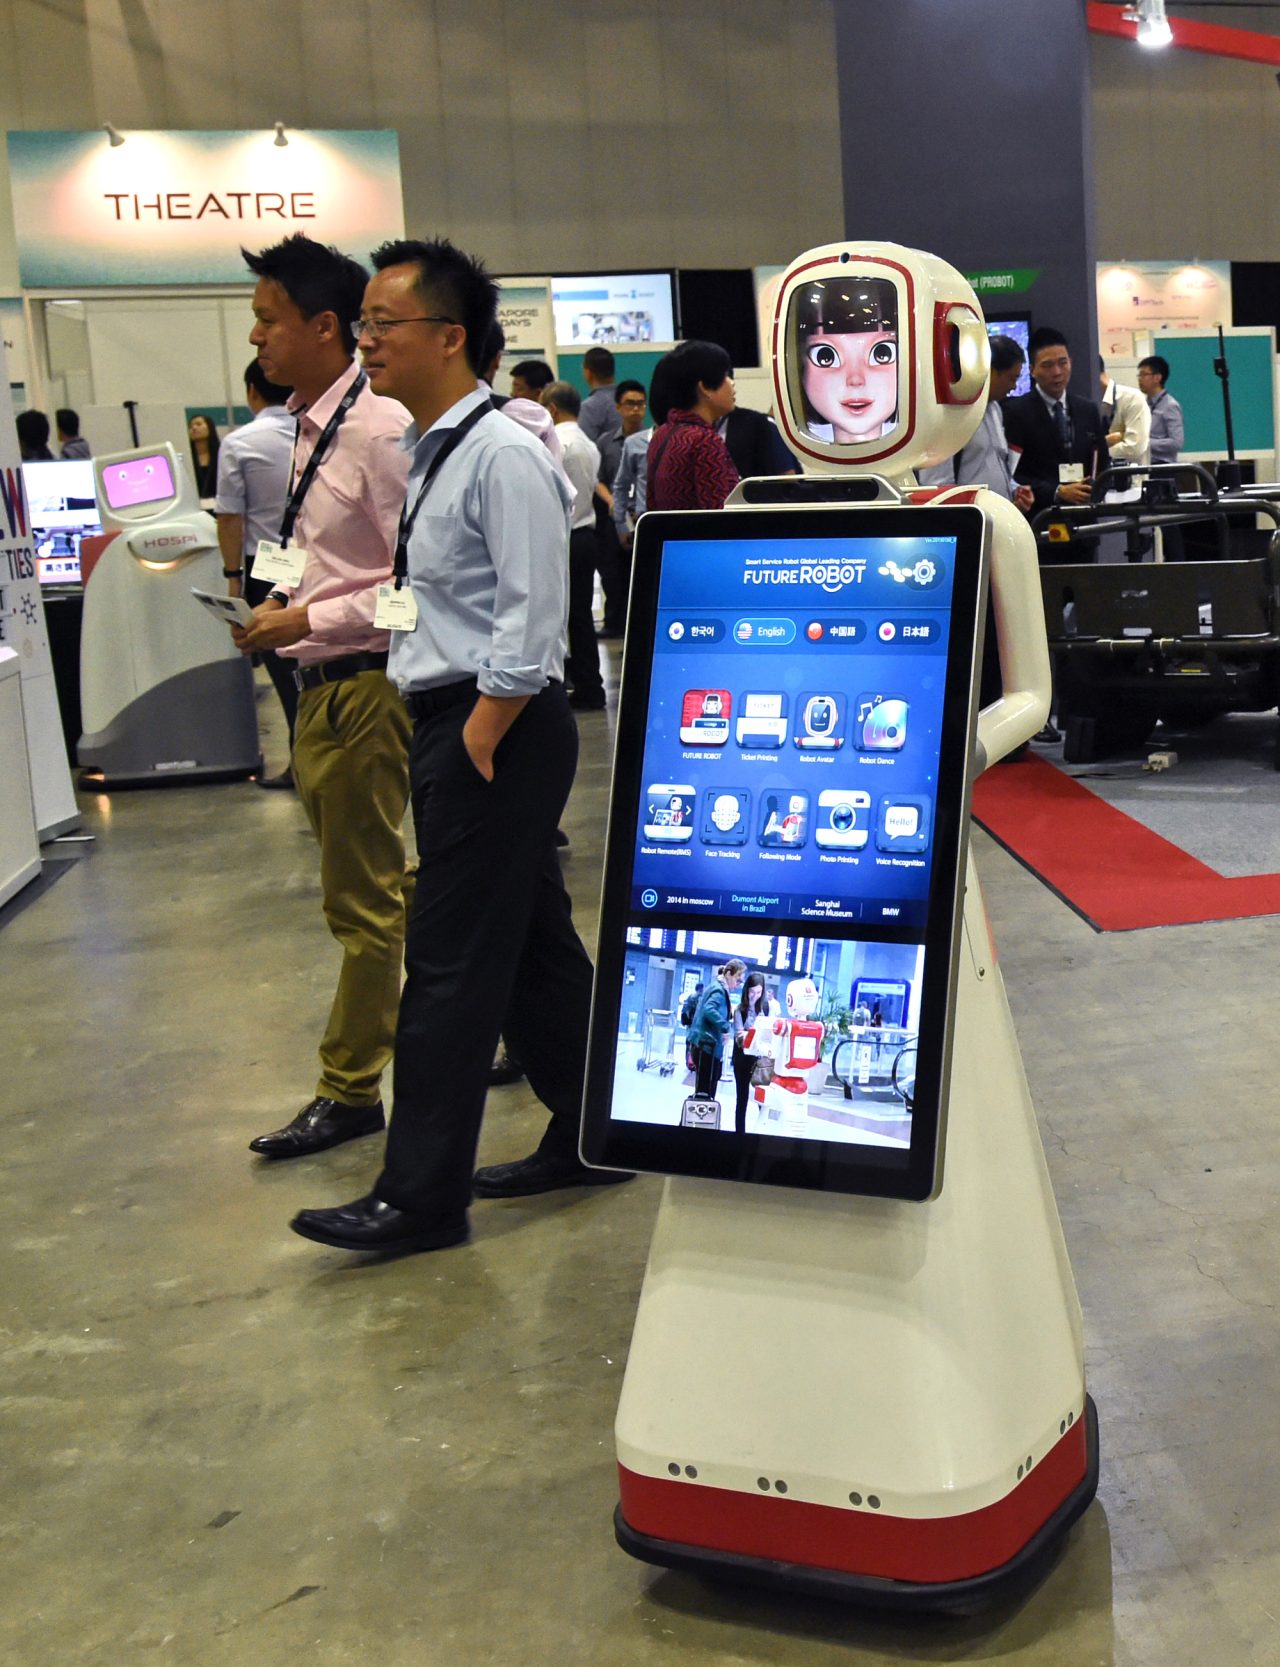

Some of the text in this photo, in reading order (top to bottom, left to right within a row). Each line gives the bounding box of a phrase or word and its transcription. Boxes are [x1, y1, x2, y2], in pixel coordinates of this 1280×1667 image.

[103, 192, 316, 220] THEATRE
[979, 275, 1015, 290] (PROBOT)
[818, 558, 841, 566] Leading
[841, 558, 867, 566] Company
[690, 625, 716, 638] 한국어
[757, 625, 787, 639] English
[902, 625, 930, 638] 日本語
[682, 752, 722, 760] FUTURE ROBOT
[741, 753, 778, 763] Ticket Printing
[799, 755, 834, 764] Robot Avatar
[859, 757, 876, 766] Robot
[889, 817, 914, 827] Hello!
[641, 846, 657, 855] Robot
[705, 849, 740, 859] Face Tracking
[759, 852, 802, 862] Following Mode
[820, 854, 859, 864] Photo Printing
[876, 857, 925, 867] Voice Recognition
[667, 896, 682, 904] 2014
[731, 895, 779, 904] Dumont Airport
[815, 900, 840, 909] Sanghai
[749, 904, 766, 913] Brazil
[801, 907, 853, 918] Science Museum
[882, 907, 900, 917] BMW
